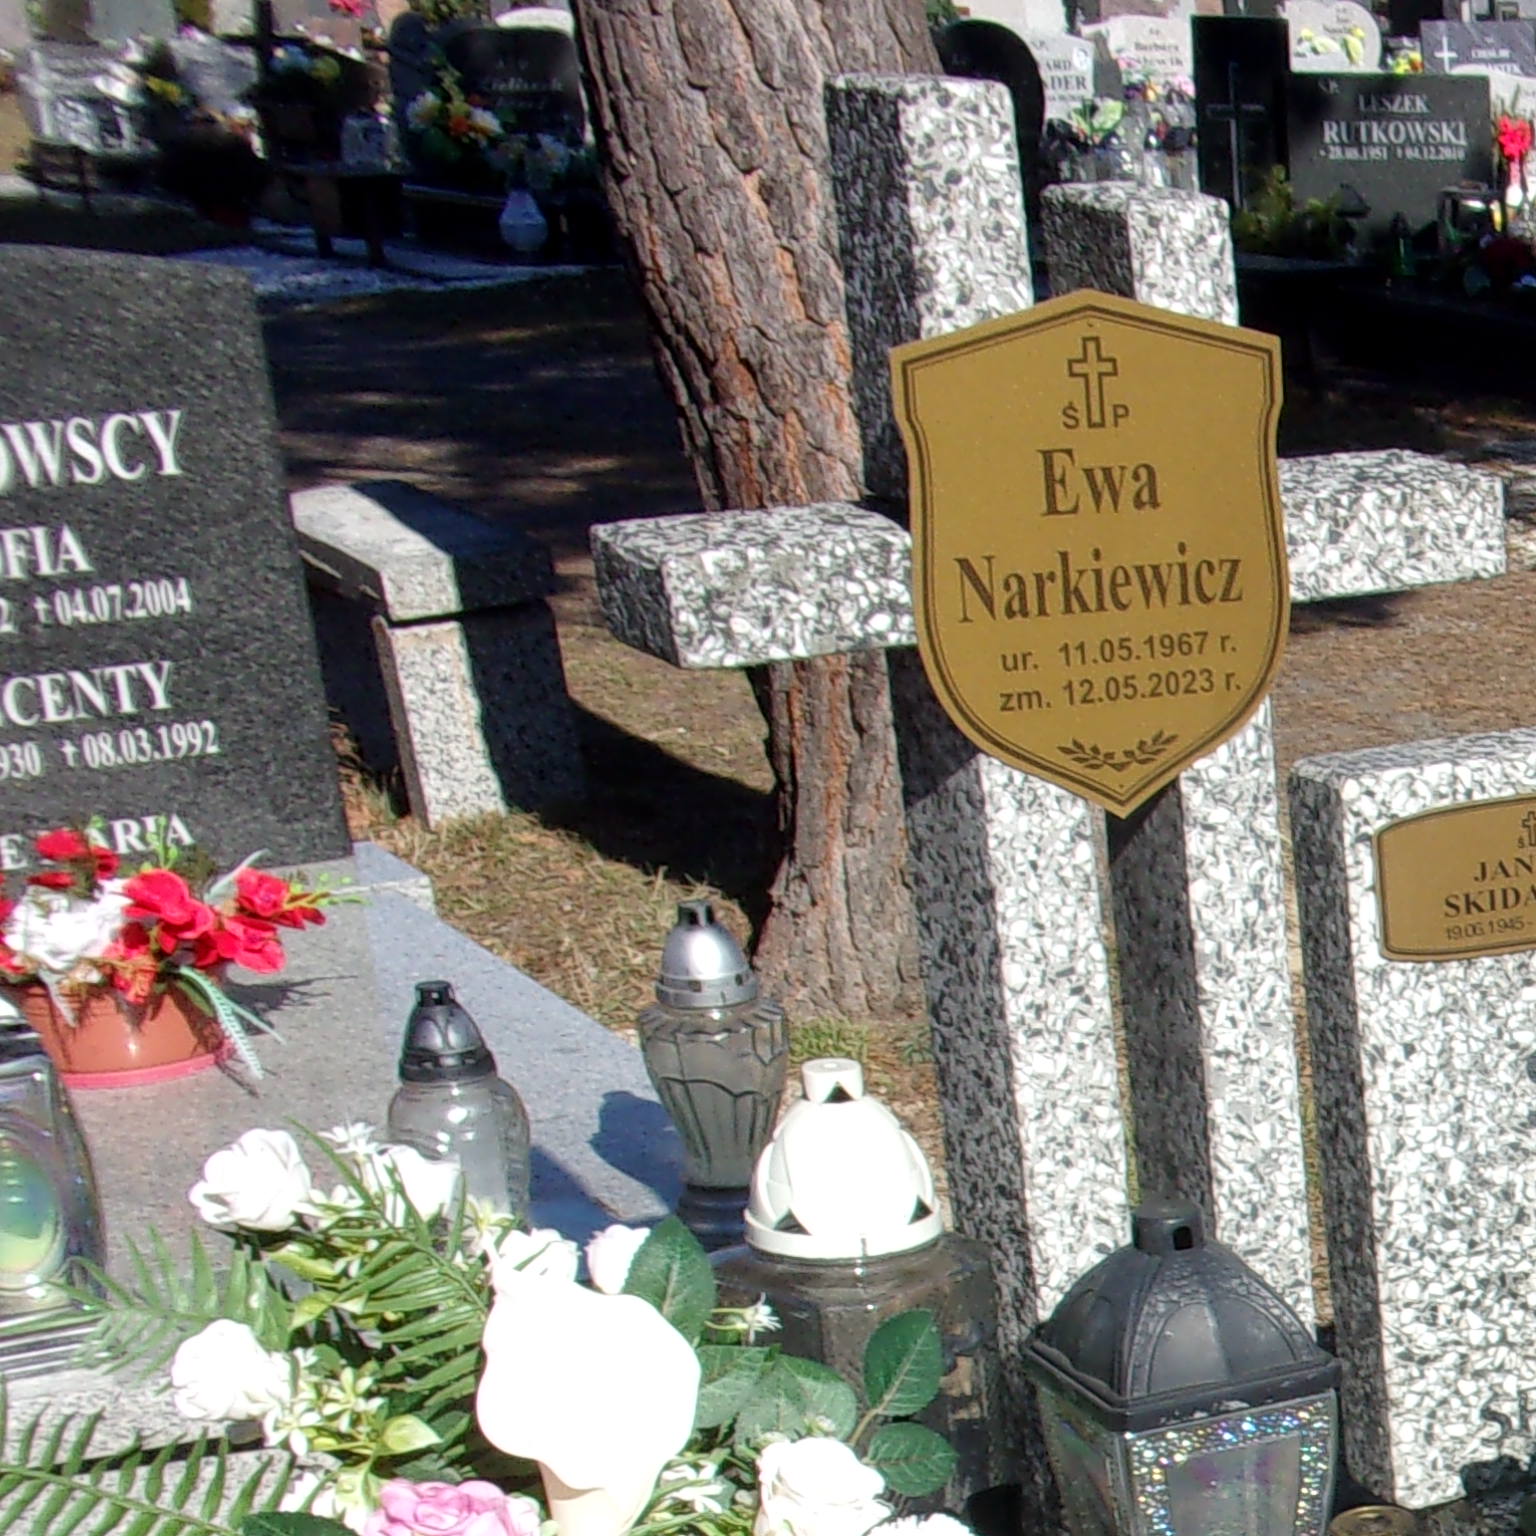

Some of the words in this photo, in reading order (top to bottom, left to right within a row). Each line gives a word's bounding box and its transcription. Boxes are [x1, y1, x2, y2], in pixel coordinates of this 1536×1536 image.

[1358, 93, 1431, 113] LESZEK
[1322, 119, 1468, 146] RUTKOWSKI
[1036, 447, 1162, 517] Ewa
[953, 542, 1245, 624] Narkiewicz
[1000, 650, 1039, 673] ur.
[1058, 630, 1210, 668] 11.05.1967
[1218, 633, 1238, 653] r.
[1000, 689, 1052, 712] zm.
[1062, 667, 1215, 706] 12.05.2023
[1223, 671, 1242, 692] r.
